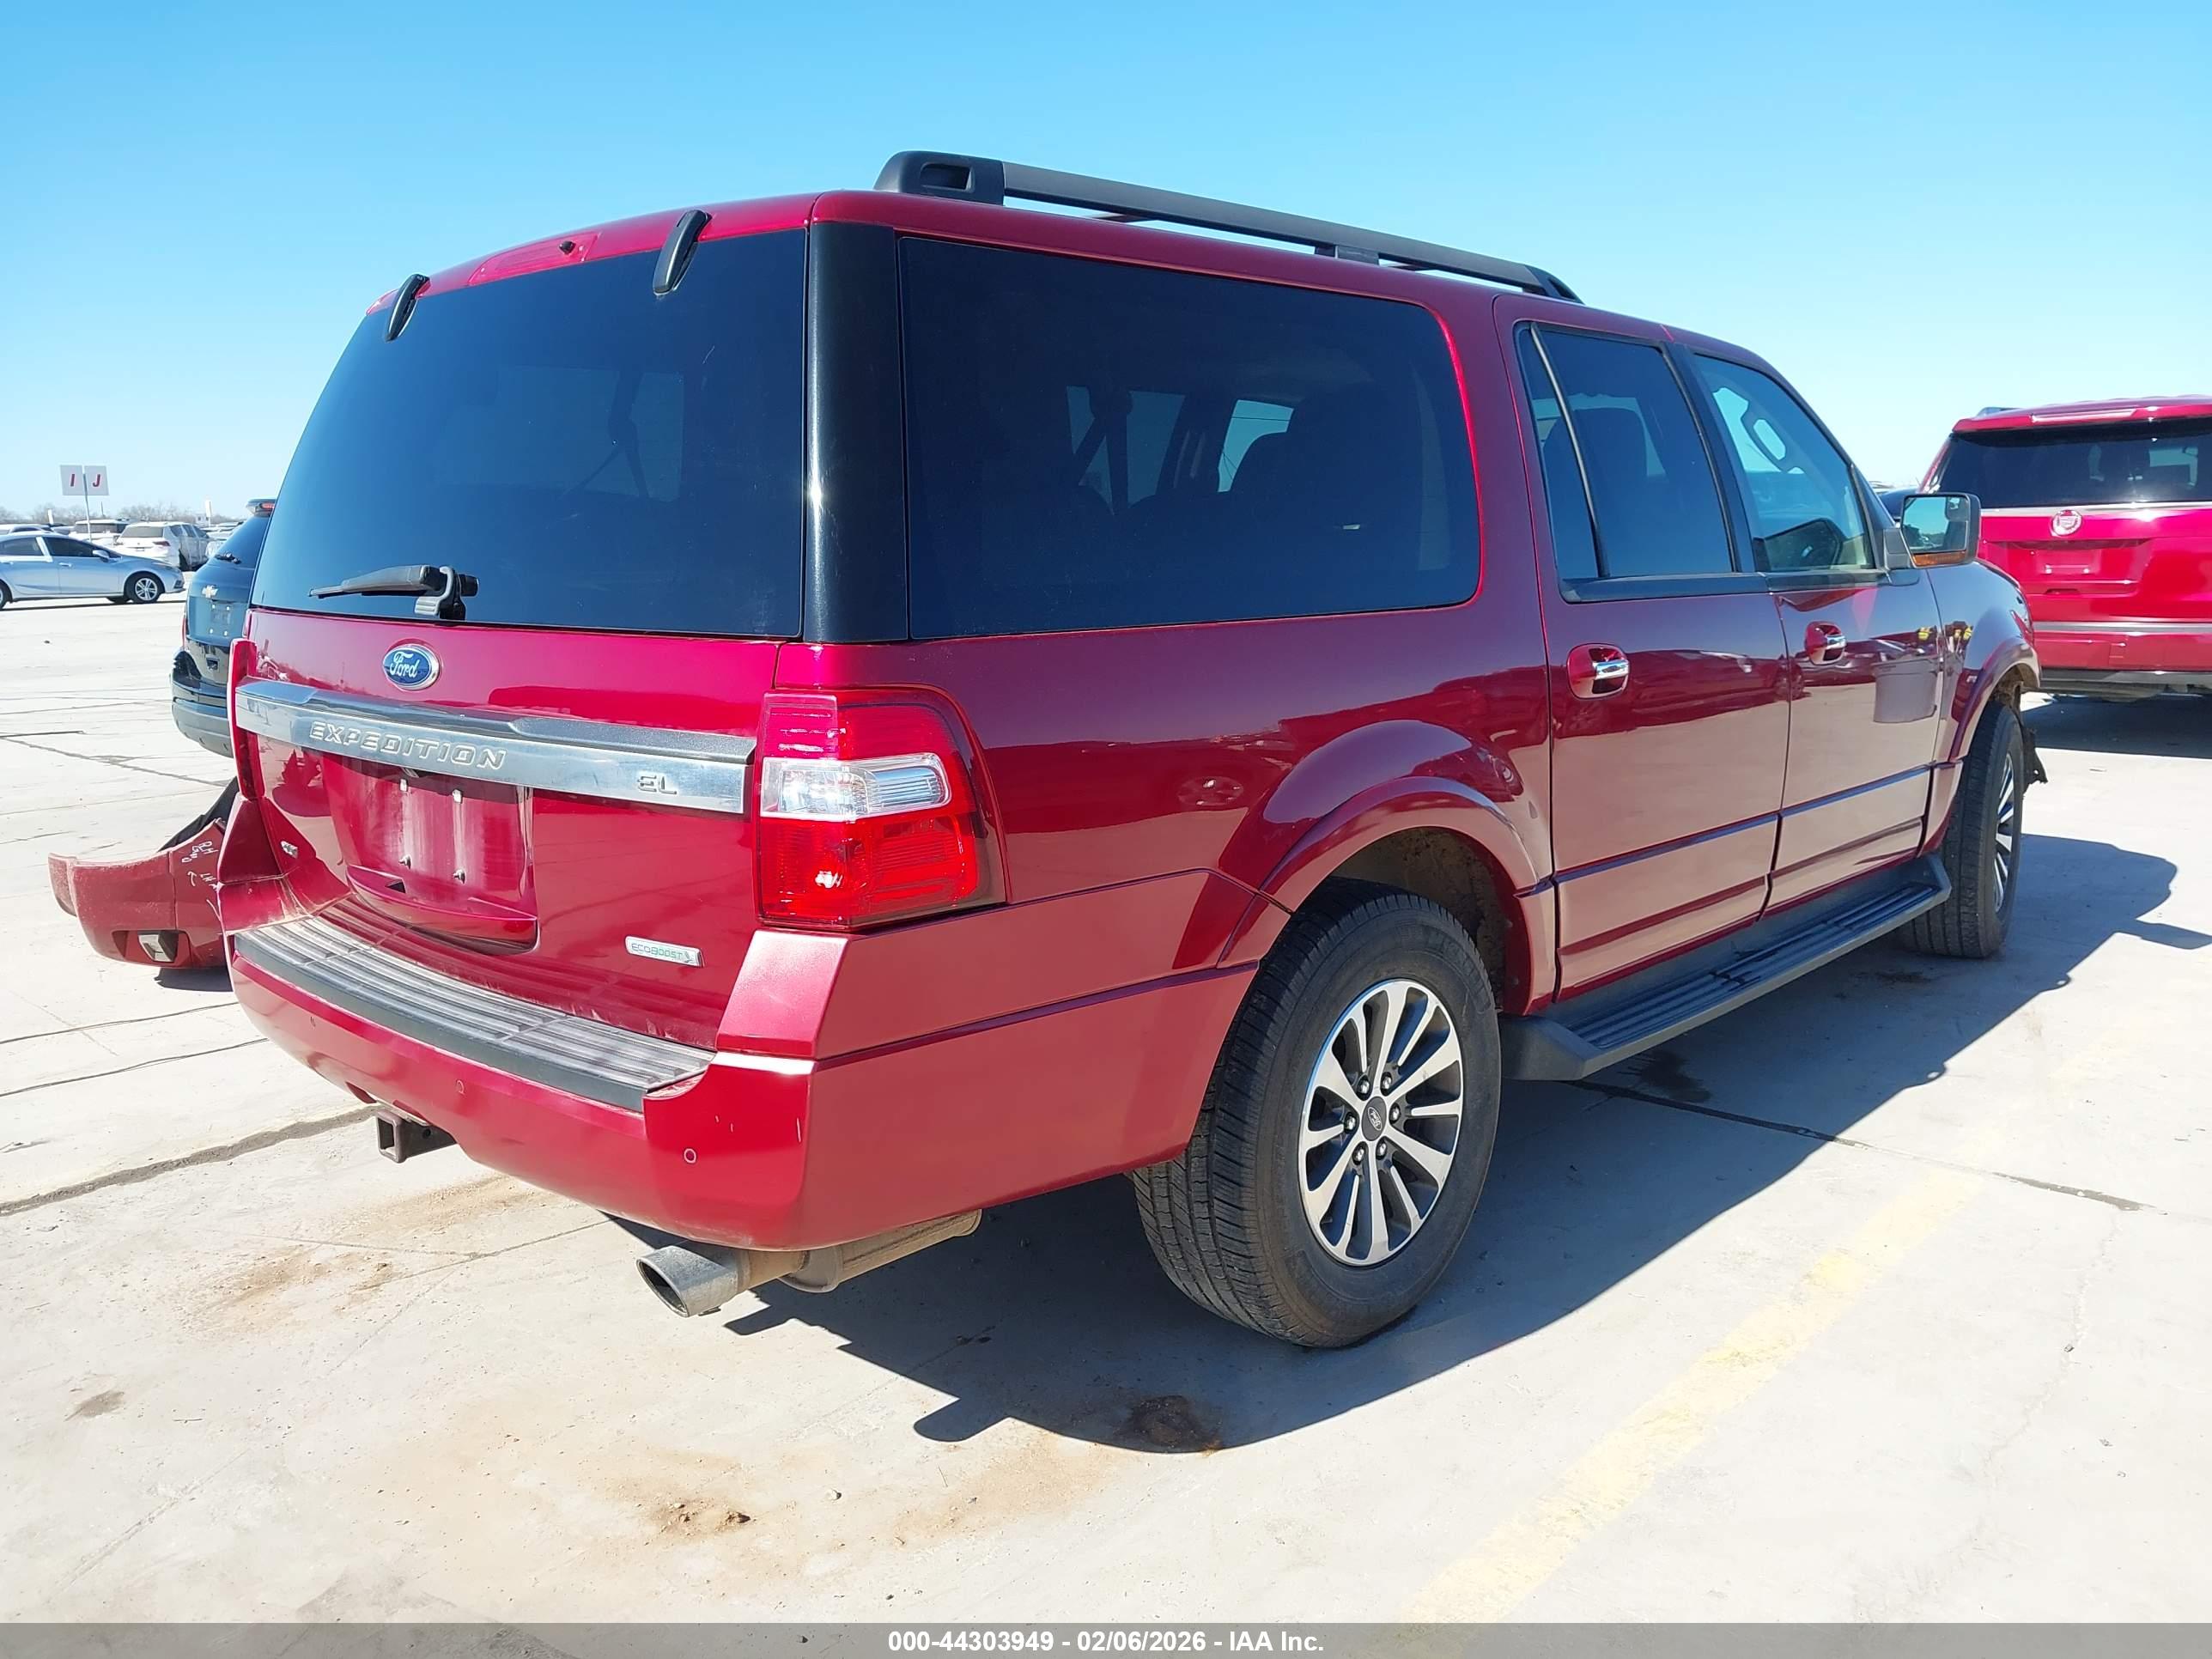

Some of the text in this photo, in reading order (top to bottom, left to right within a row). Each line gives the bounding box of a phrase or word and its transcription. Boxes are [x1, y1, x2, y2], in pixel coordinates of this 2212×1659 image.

[70, 473, 76, 487] I
[92, 473, 101, 488] J
[389, 651, 418, 678] Ford
[309, 720, 678, 795] EXPEDITION EL
